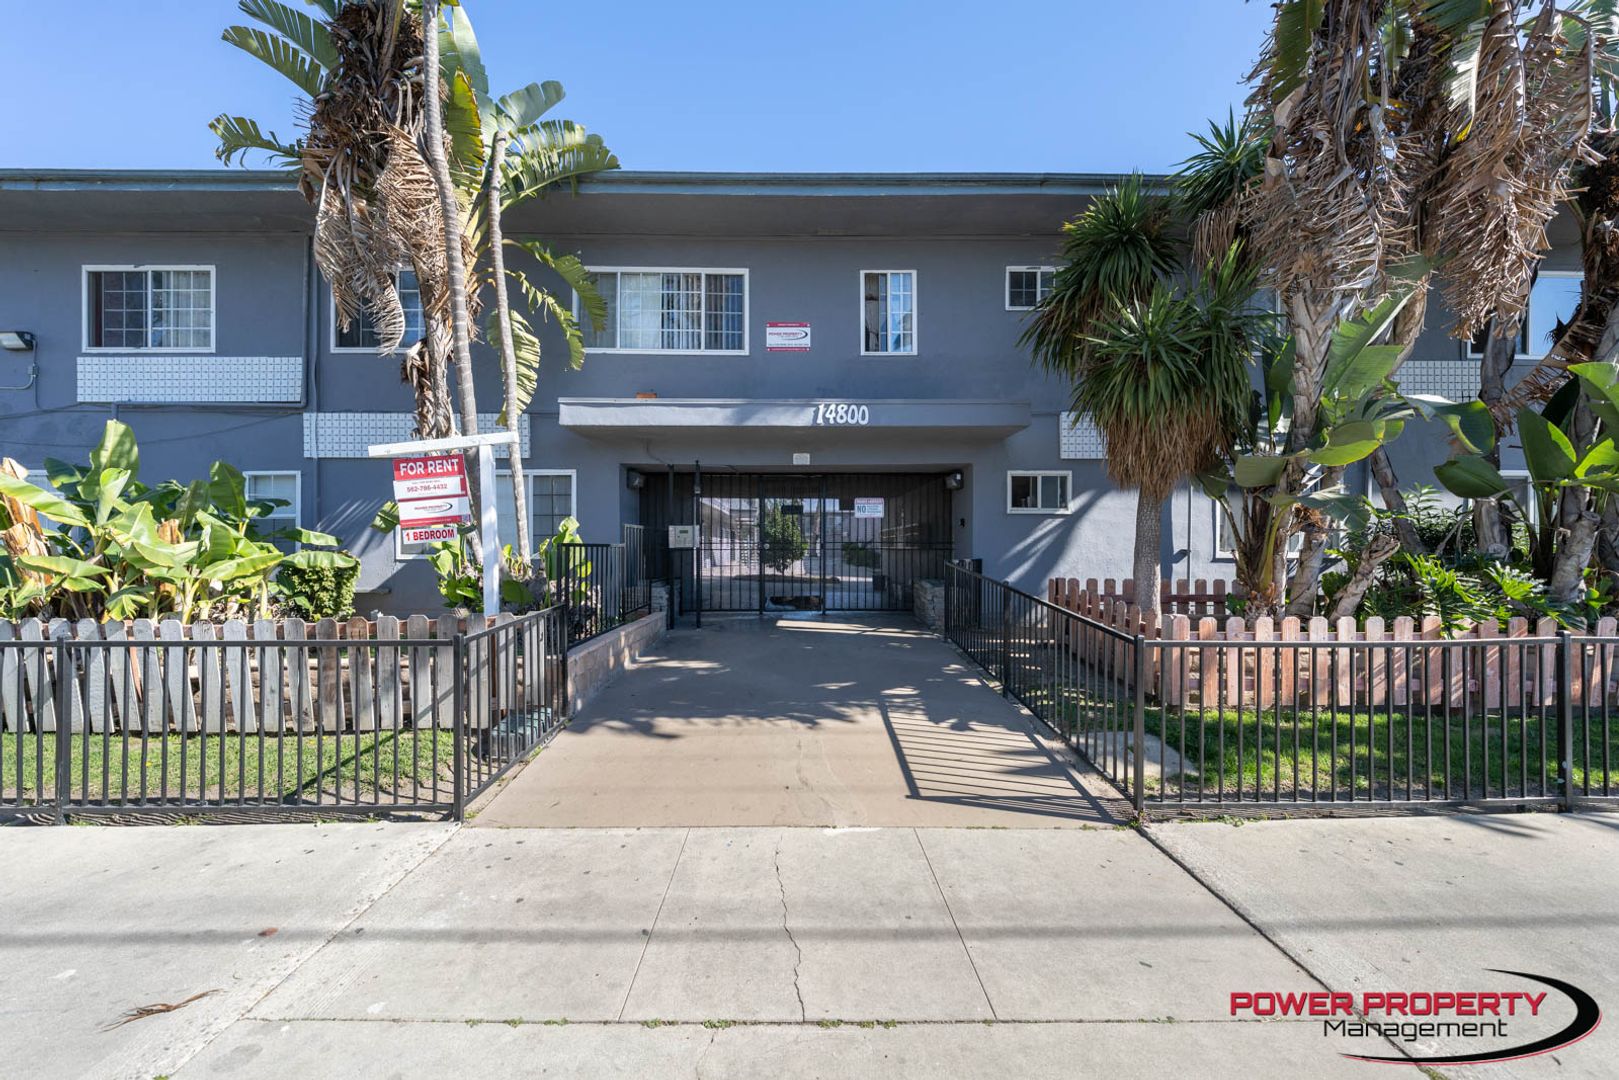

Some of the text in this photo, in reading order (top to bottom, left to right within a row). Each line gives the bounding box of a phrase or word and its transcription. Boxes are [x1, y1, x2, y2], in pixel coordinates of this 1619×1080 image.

[816, 403, 869, 425] 14800
[399, 458, 459, 476] FOR RENT
[857, 504, 867, 513] NO
[405, 528, 455, 542] 1 BEDROOM
